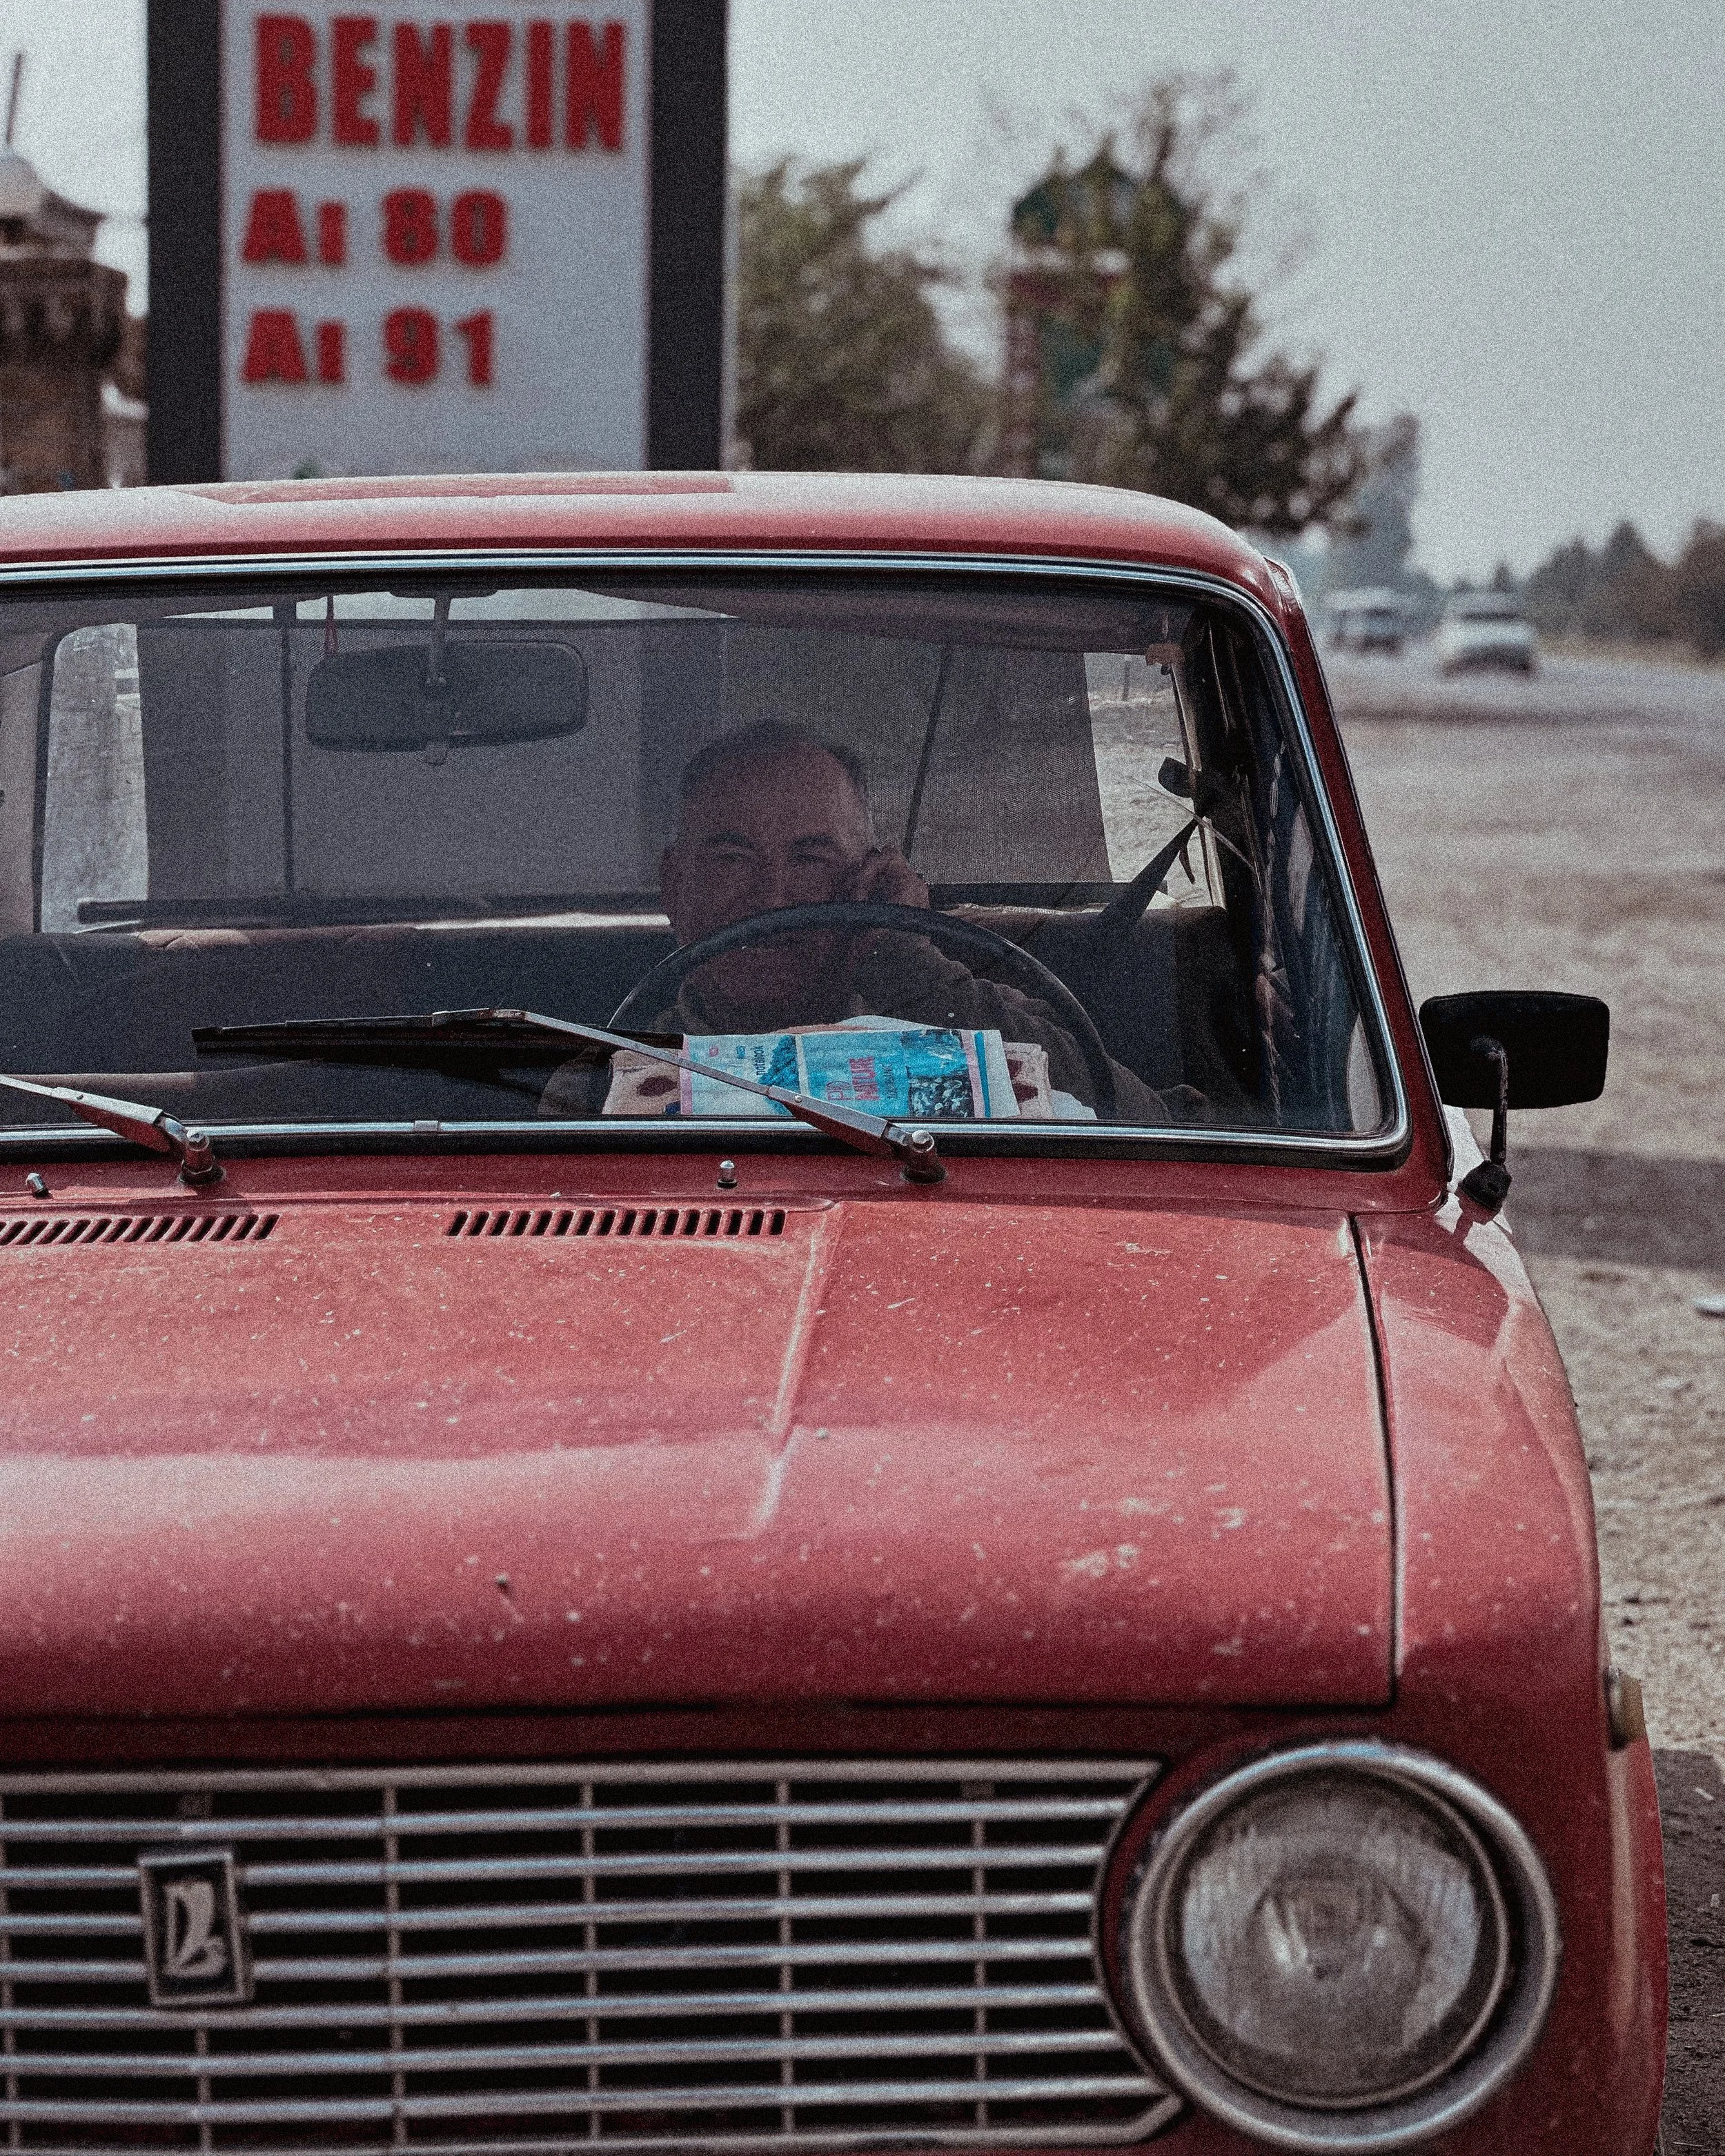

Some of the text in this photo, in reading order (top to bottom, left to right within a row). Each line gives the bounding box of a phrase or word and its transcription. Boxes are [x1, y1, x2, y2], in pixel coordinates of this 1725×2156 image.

[253, 12, 627, 152] BENZIN
[381, 187, 509, 268] 80
[382, 306, 494, 386] 91
